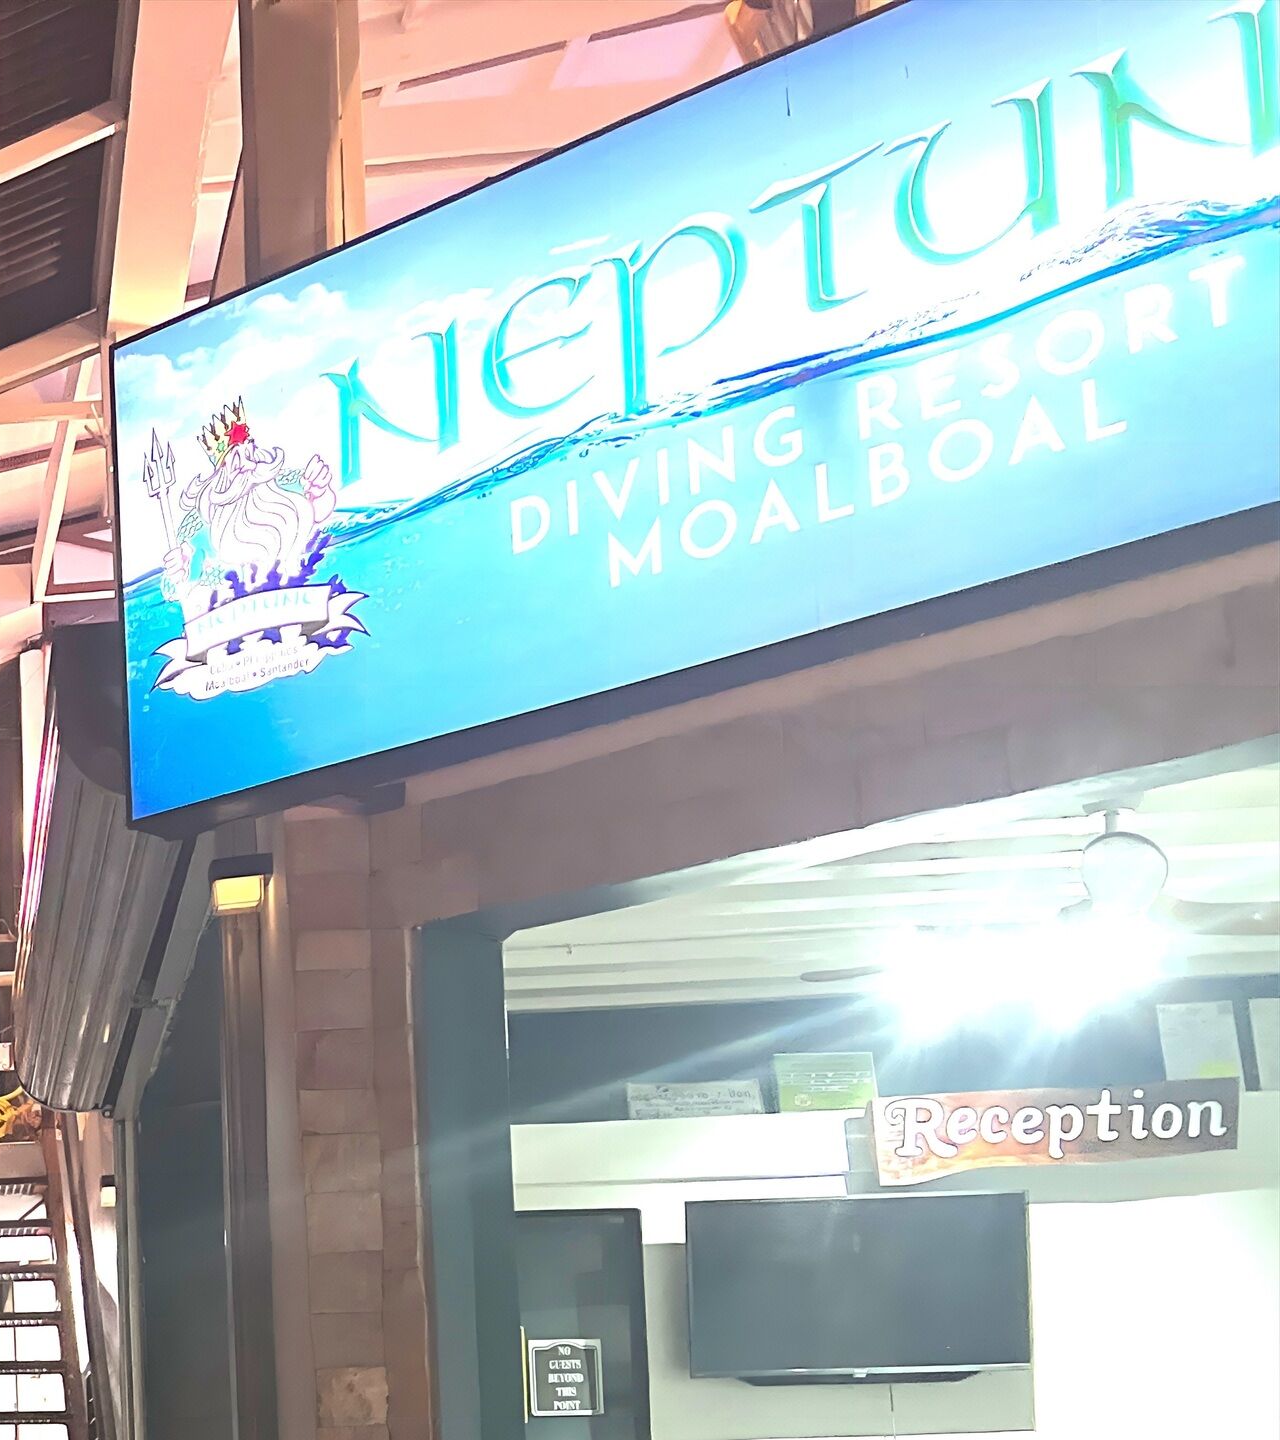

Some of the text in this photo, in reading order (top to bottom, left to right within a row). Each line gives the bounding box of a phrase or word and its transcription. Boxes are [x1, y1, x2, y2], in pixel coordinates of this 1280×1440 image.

[510, 256, 1246, 556] DIVING RESORT
[607, 378, 1128, 588] MOALBOAL
[259, 657, 310, 678] Santander
[884, 1088, 1228, 1159] Reception
[557, 1346, 571, 1356] NO
[549, 1359, 582, 1370] GUESTS
[547, 1372, 584, 1384] BEYOND
[555, 1386, 577, 1397] THIS
[553, 1400, 581, 1411] POINT
